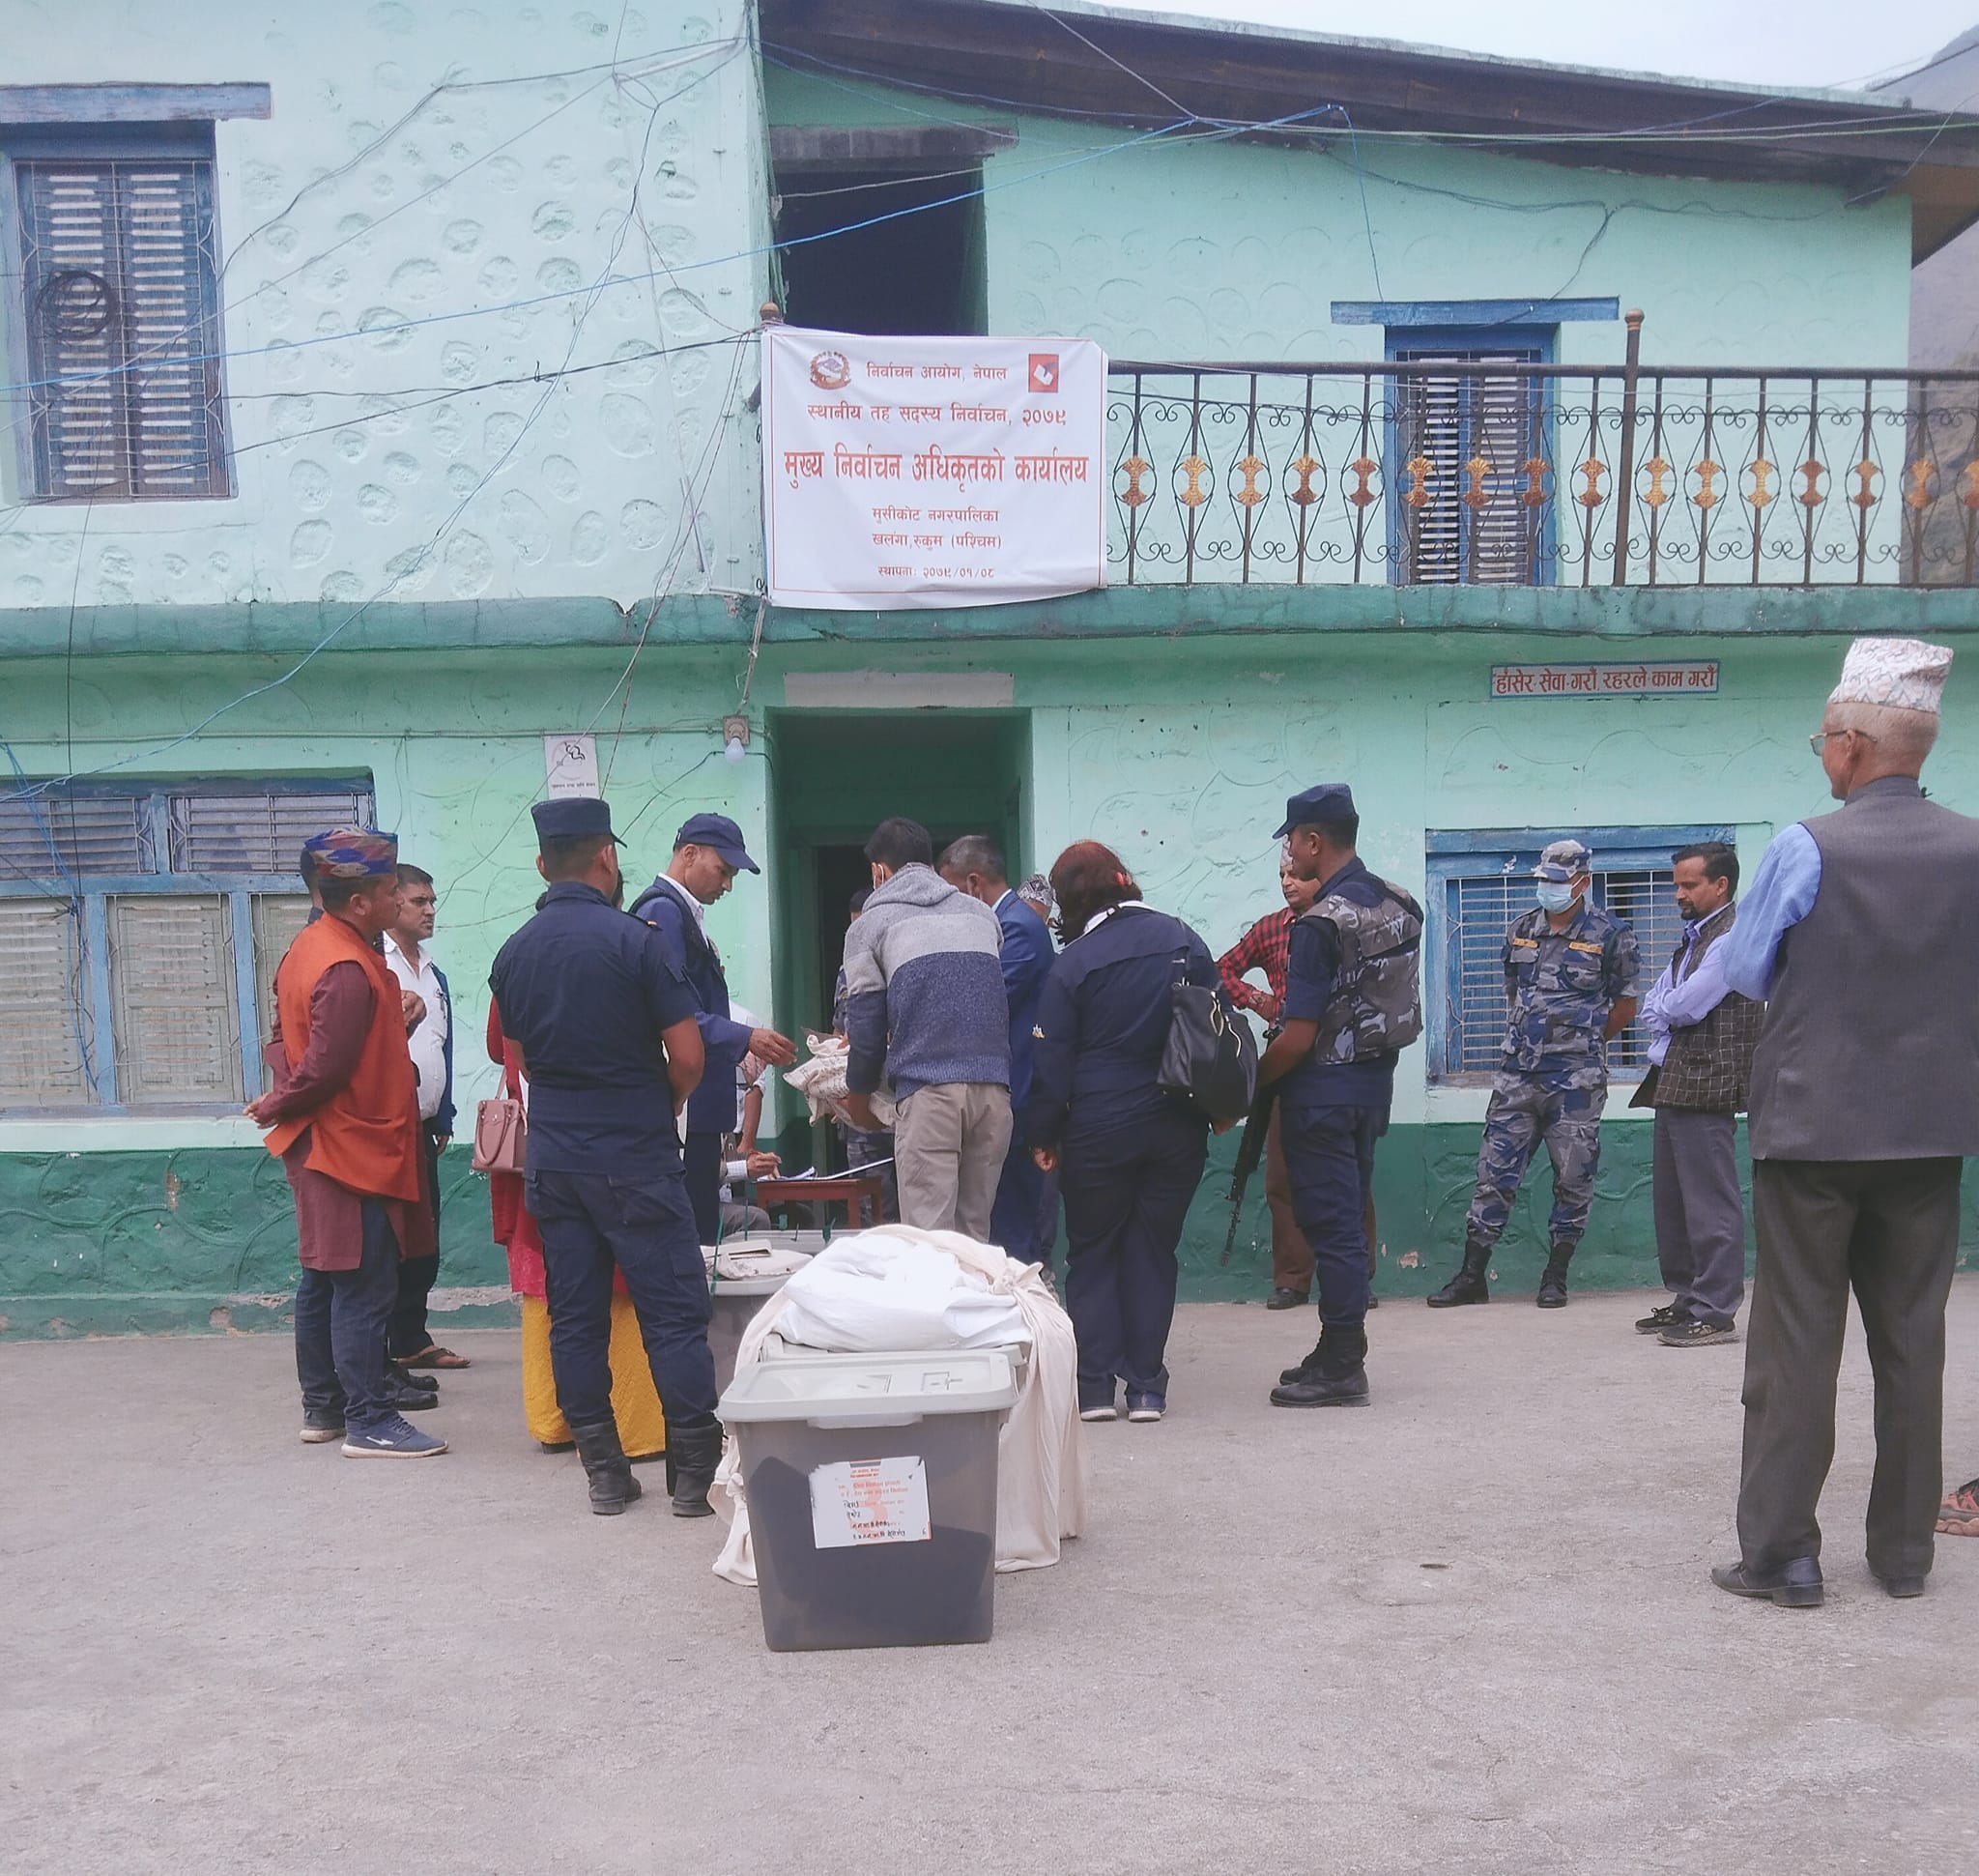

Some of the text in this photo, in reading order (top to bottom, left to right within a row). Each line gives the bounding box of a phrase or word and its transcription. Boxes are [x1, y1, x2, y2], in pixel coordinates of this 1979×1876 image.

[867, 361, 913, 378] निर्वाचन
[973, 365, 1008, 380] नेपाल
[808, 401, 862, 420] स्थानीय
[871, 405, 890, 423] तह
[899, 405, 941, 423] सदस्य
[1022, 409, 1067, 426] २०७९
[784, 442, 1090, 492] मुख्य निर्वाचन अधिकृतको कार्यालय
[928, 505, 1000, 523] नगरपालिका
[1538, 668, 1567, 692] सेवा
[1602, 666, 1648, 689] रहरले
[1651, 671, 1684, 687] काम
